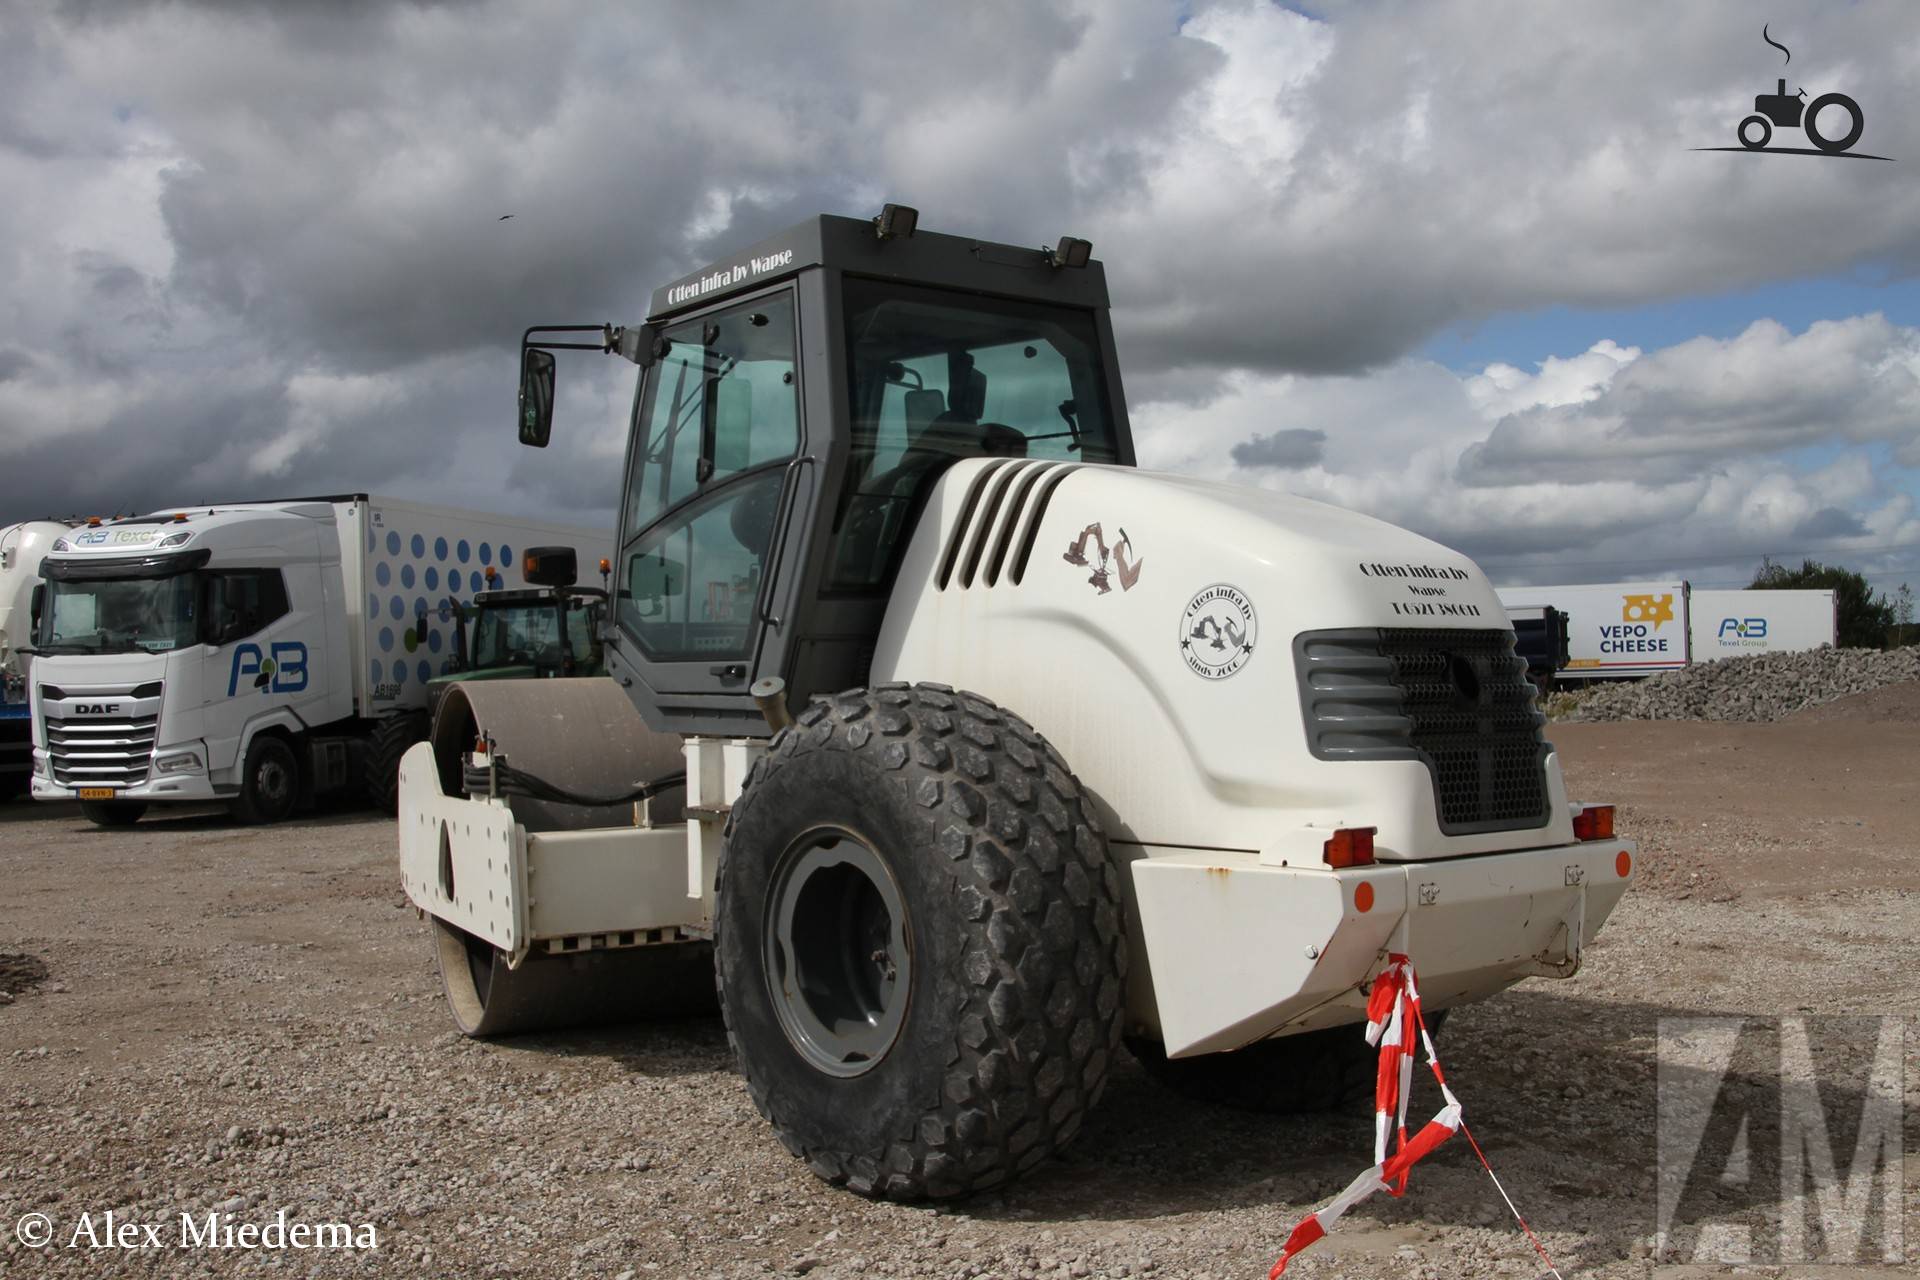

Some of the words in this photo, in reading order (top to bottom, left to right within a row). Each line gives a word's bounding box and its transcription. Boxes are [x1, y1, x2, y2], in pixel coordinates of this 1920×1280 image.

[701, 272, 731, 294] infra
[750, 249, 793, 275] Wapse
[1406, 564, 1450, 579] infra
[1216, 587, 1243, 606] infra
[1408, 585, 1447, 597] Wapse
[1600, 624, 1647, 639] VEPO
[1718, 618, 1767, 638] AB
[1600, 639, 1668, 653] CHEESE
[1718, 639, 1740, 647] Texel
[1741, 639, 1767, 648] Group
[227, 641, 308, 697] AB
[75, 703, 120, 714] DAF
